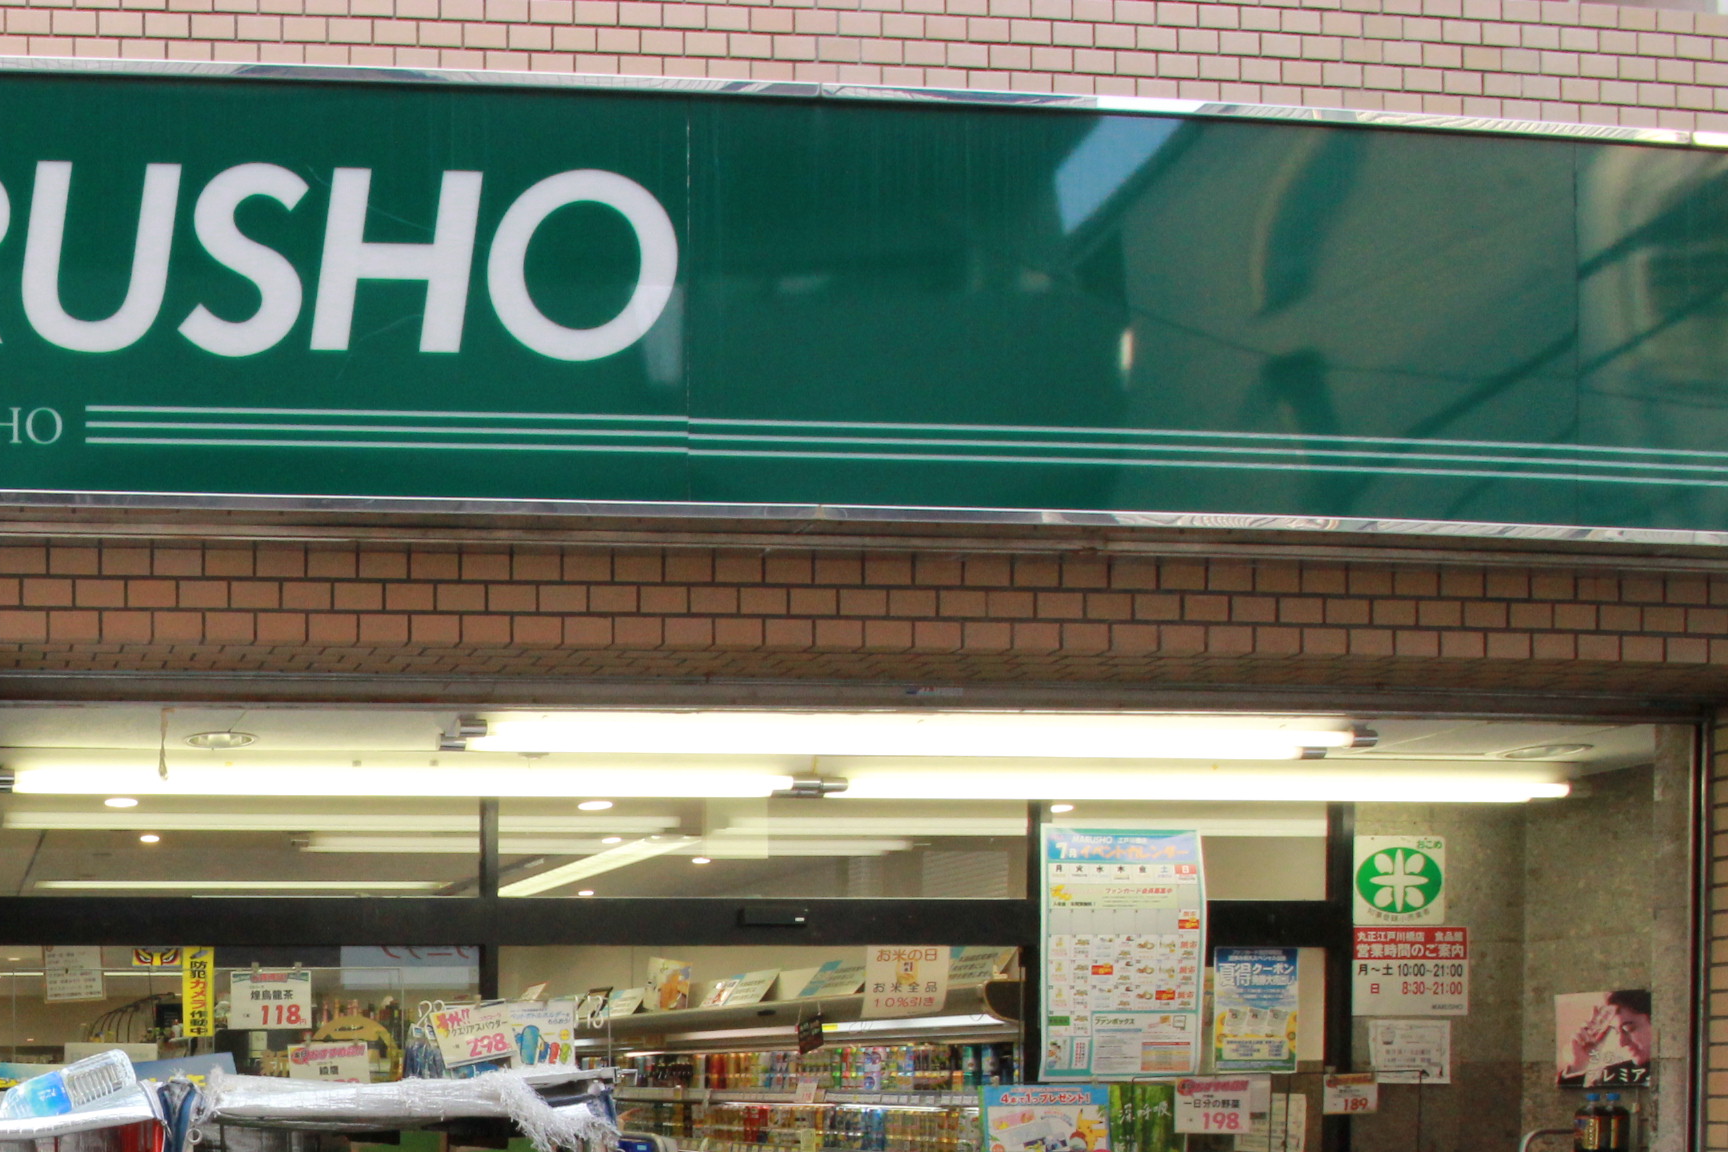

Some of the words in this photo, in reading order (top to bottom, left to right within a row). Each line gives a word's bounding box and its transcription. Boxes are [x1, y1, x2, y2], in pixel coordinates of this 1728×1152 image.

[876, 948, 938, 962] お米の日
[1356, 944, 1465, 958] 営業時間のご案内
[1370, 984, 1380, 994] 日
[190, 961, 208, 1035] 防犯カメラ作動中
